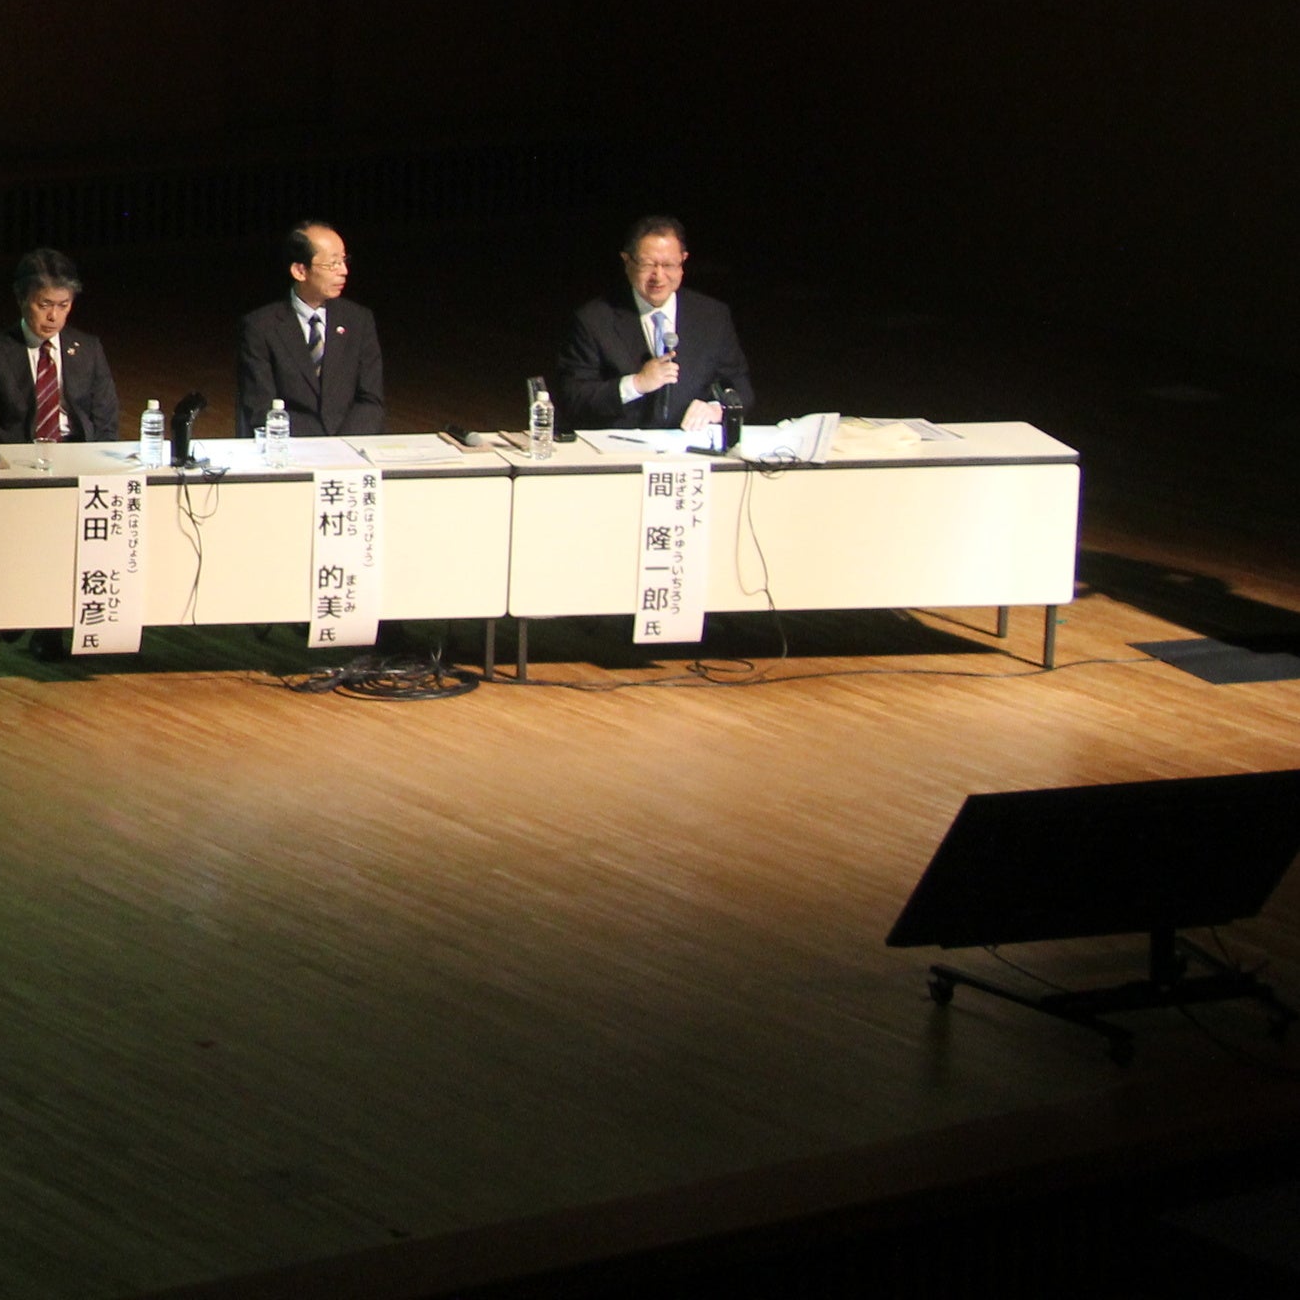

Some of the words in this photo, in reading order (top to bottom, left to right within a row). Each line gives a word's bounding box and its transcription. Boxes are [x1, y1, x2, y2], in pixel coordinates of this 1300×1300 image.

[319, 480, 345, 536] 幸村
[346, 483, 358, 536] こうむら
[648, 472, 673, 497] 間
[675, 472, 687, 511] はざま
[691, 469, 704, 528] コメント
[84, 484, 109, 541] 太田
[110, 495, 123, 536] おおた
[108, 569, 121, 622] としひこ
[344, 575, 356, 613] まとみ
[671, 525, 685, 615] りゅういちろう
